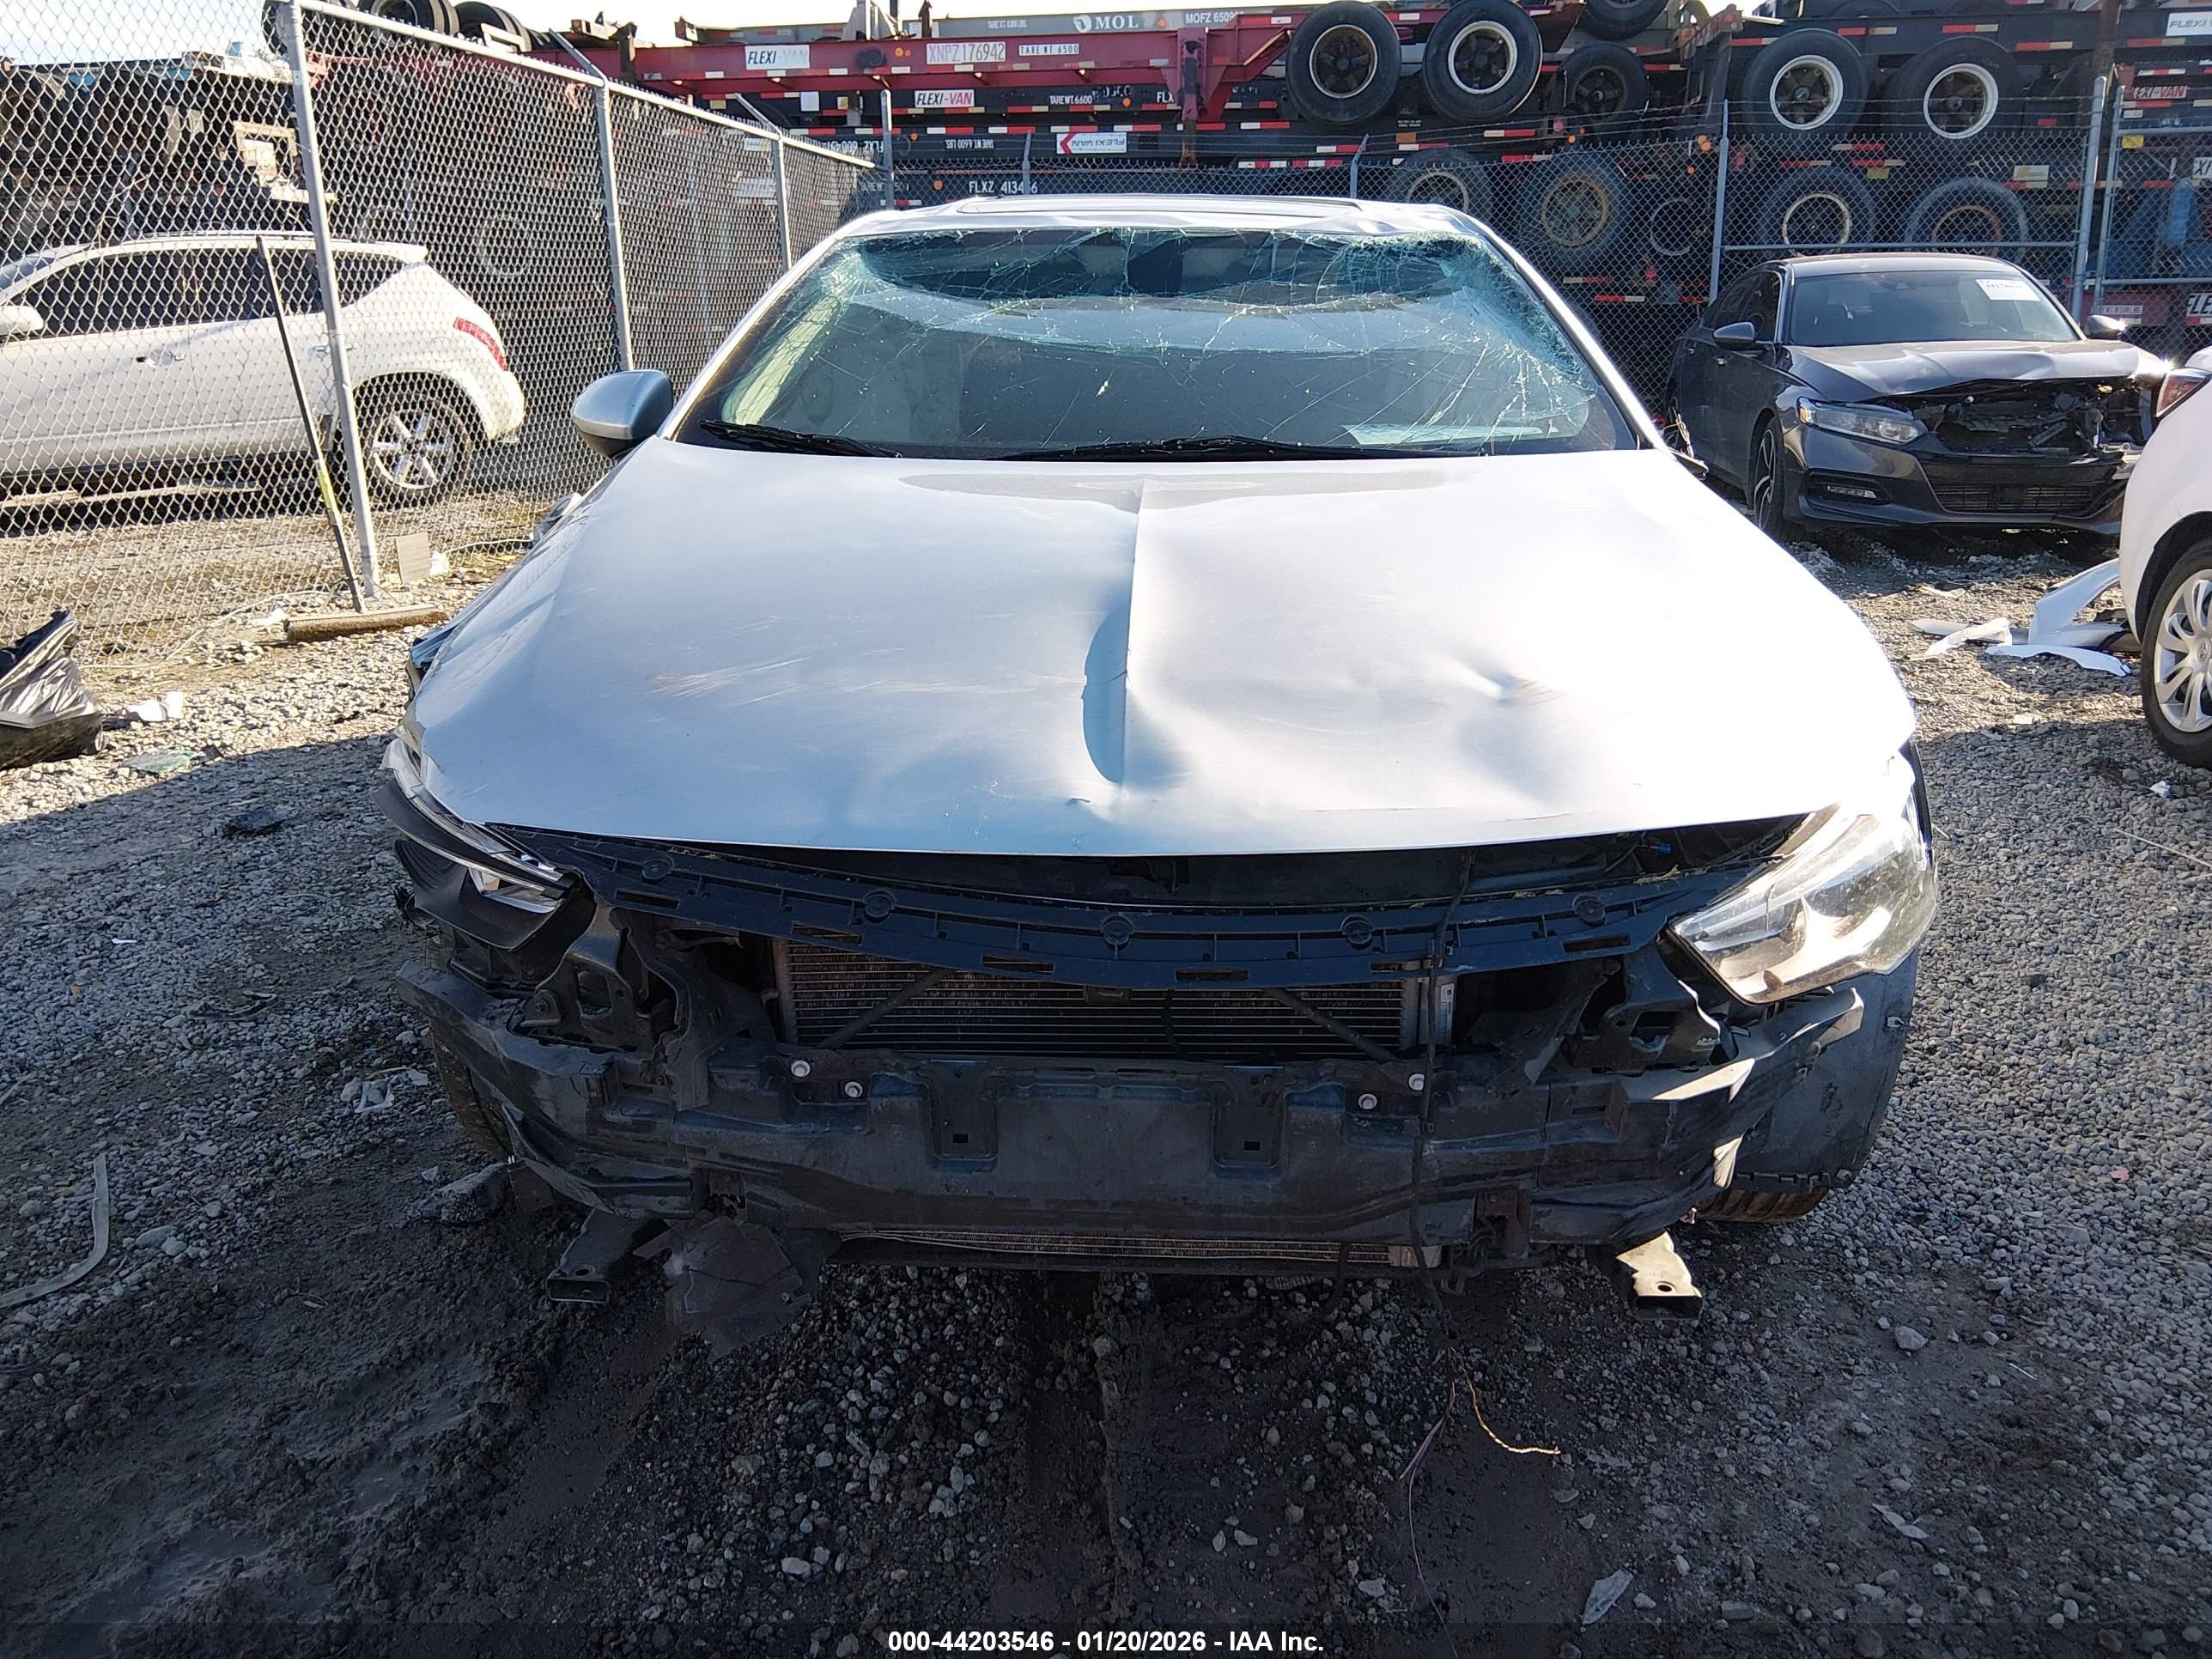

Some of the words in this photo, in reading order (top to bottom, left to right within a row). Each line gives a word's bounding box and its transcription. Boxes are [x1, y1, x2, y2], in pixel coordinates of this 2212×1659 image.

[1095, 15, 1139, 30] MOL
[1185, 12, 1212, 24] MOFZ
[1213, 10, 1244, 23] 6509
[1057, 44, 1079, 54] 6500
[916, 91, 973, 105] FLEXI-VAN
[969, 180, 995, 193] FLXZ
[1000, 180, 1038, 194] 41346
